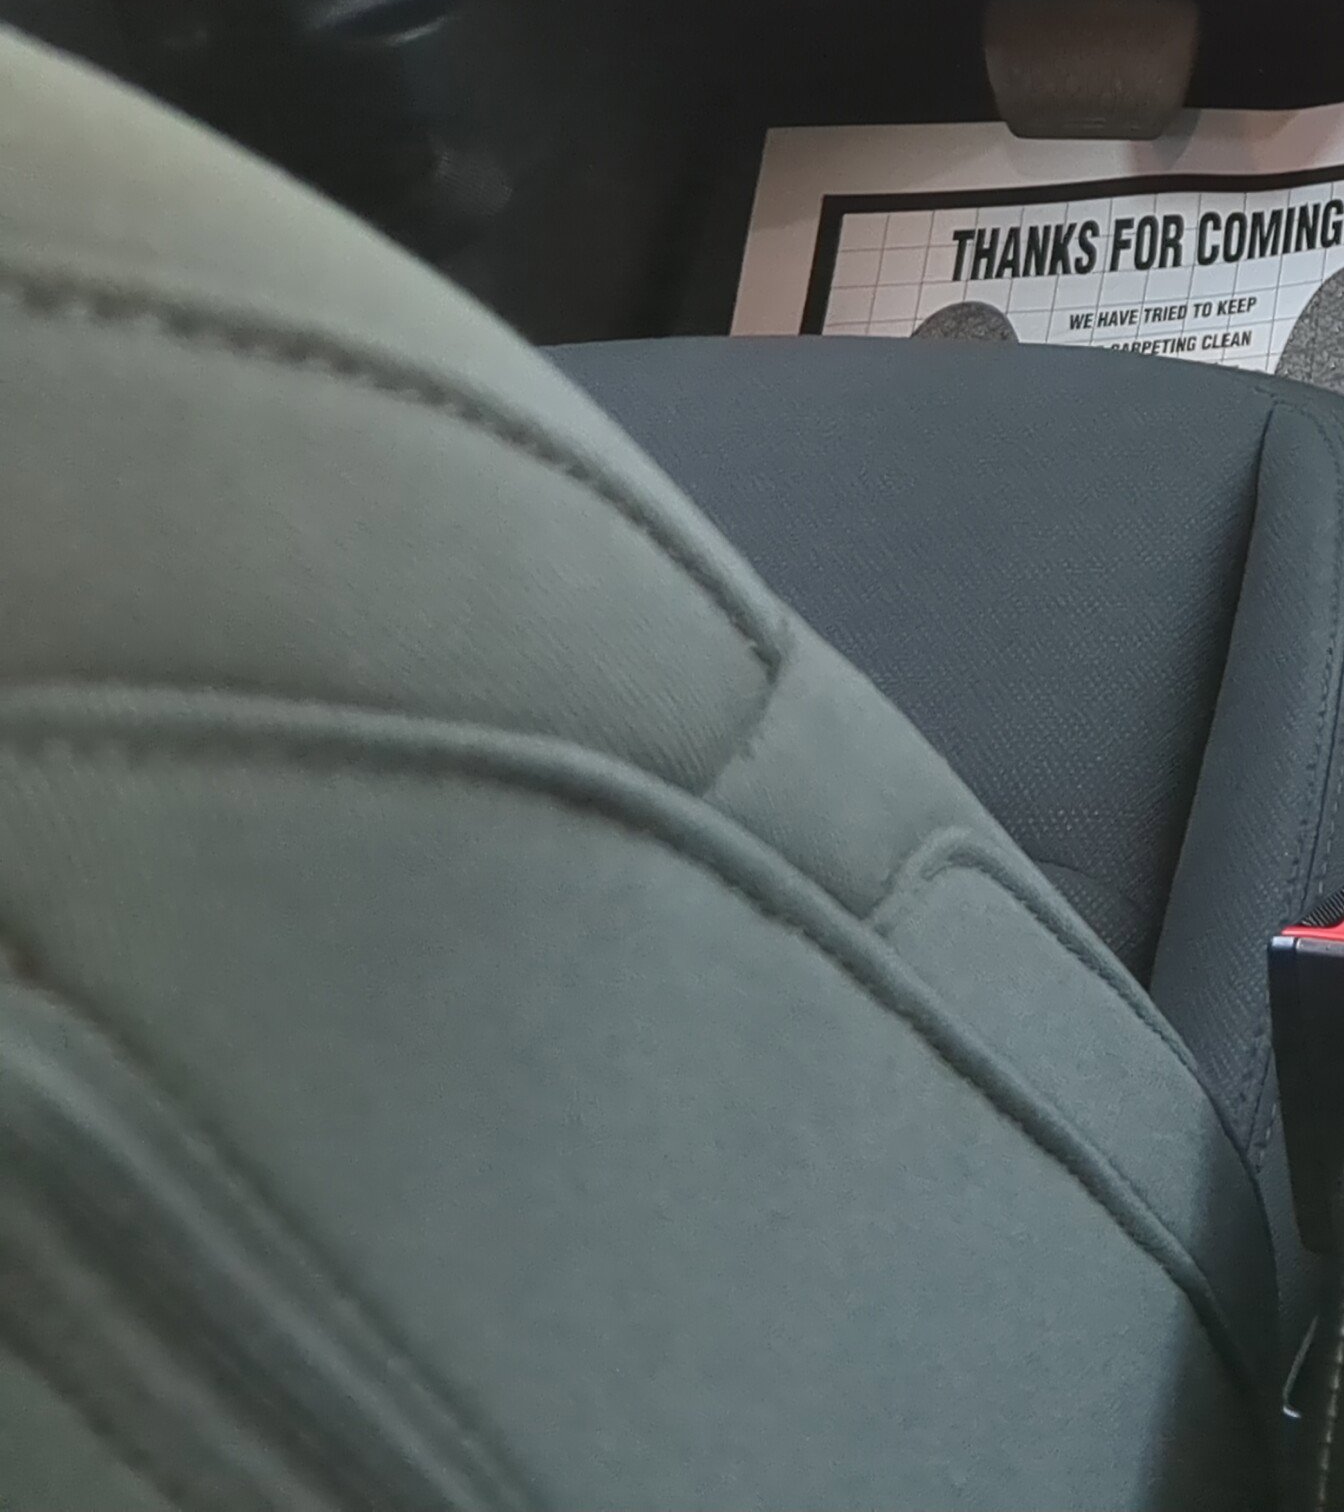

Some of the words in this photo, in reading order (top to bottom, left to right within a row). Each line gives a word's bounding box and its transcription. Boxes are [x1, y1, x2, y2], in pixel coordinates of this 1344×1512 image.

[951, 220, 1100, 282] THANKS
[1109, 214, 1185, 272] FOR
[1197, 199, 1344, 266] COMING
[1069, 314, 1094, 330] WE
[1097, 309, 1138, 327] HAVE
[1144, 304, 1187, 323] TRIED
[1194, 302, 1212, 318] TO
[1217, 297, 1257, 316] KEEP
[1202, 330, 1252, 350] CLEAN
